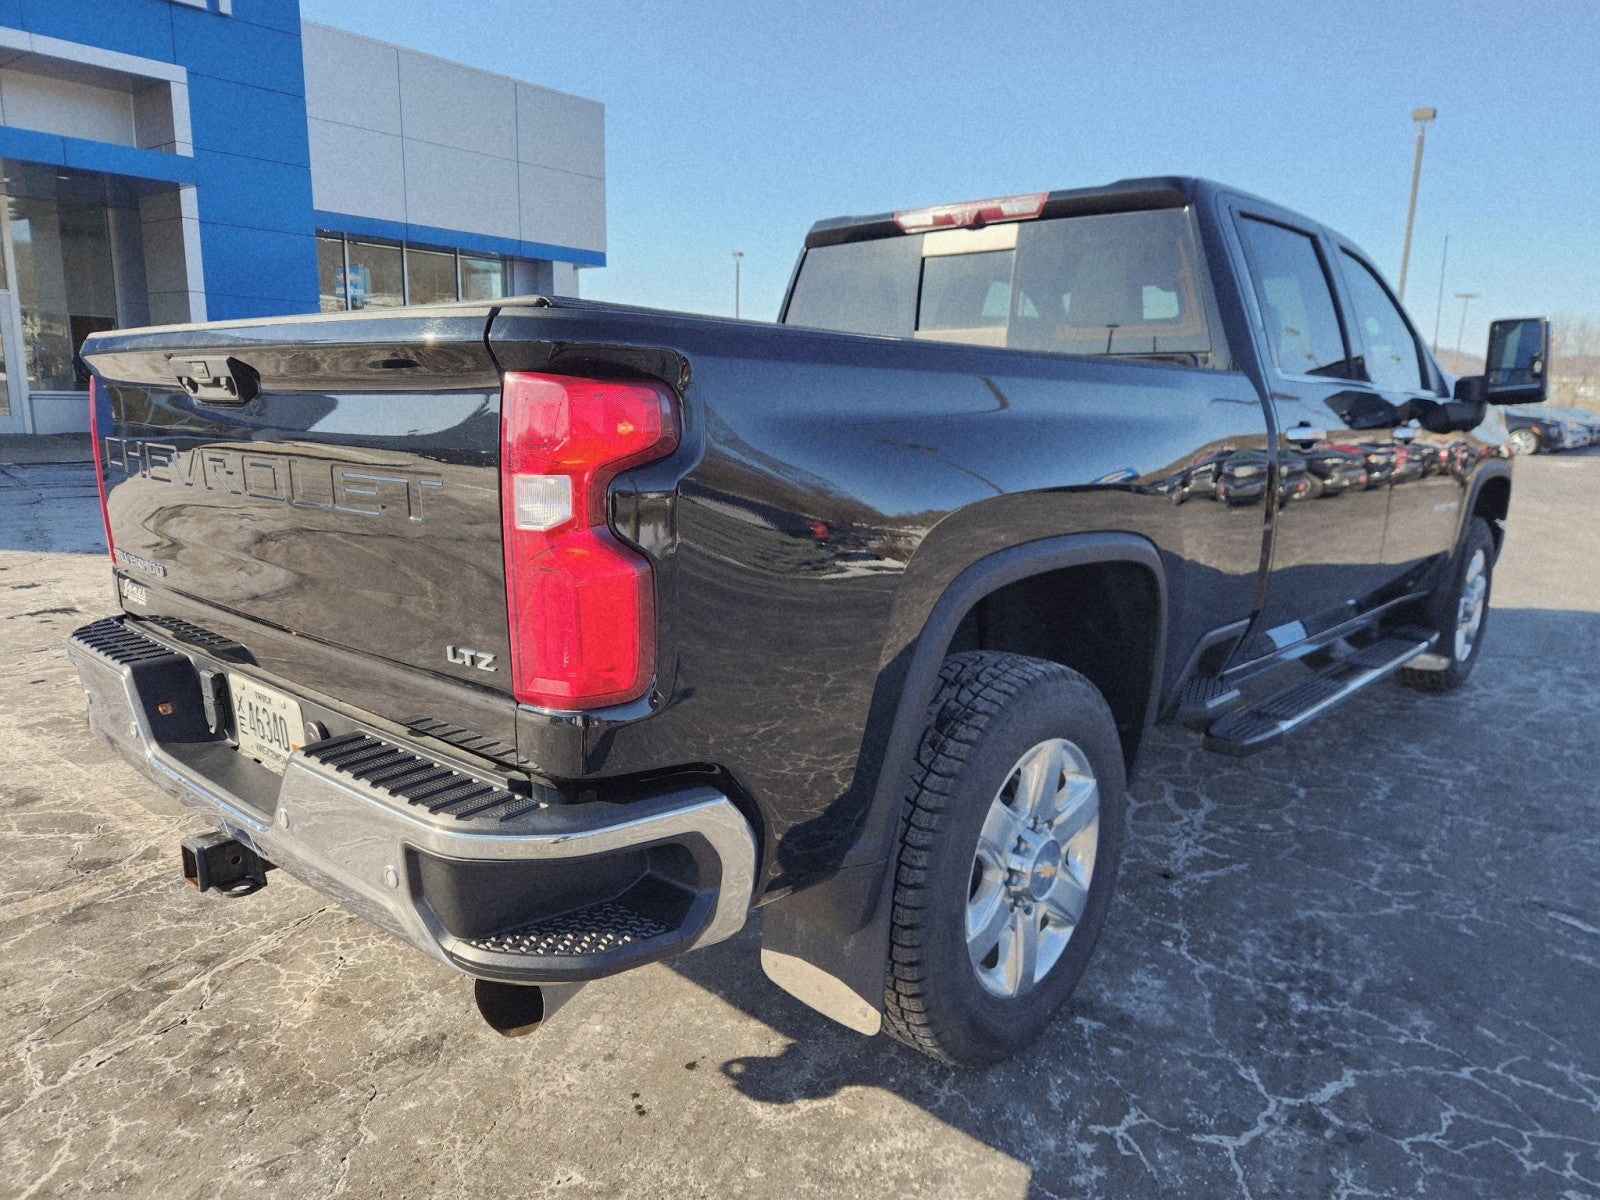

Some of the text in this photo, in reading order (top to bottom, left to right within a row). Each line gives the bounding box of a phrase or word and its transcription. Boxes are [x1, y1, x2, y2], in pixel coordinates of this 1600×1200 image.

[104, 436, 444, 522] CHEVROLET
[446, 645, 498, 672] LTZ
[254, 691, 272, 704] TRUCK
[248, 701, 290, 752] 46340
